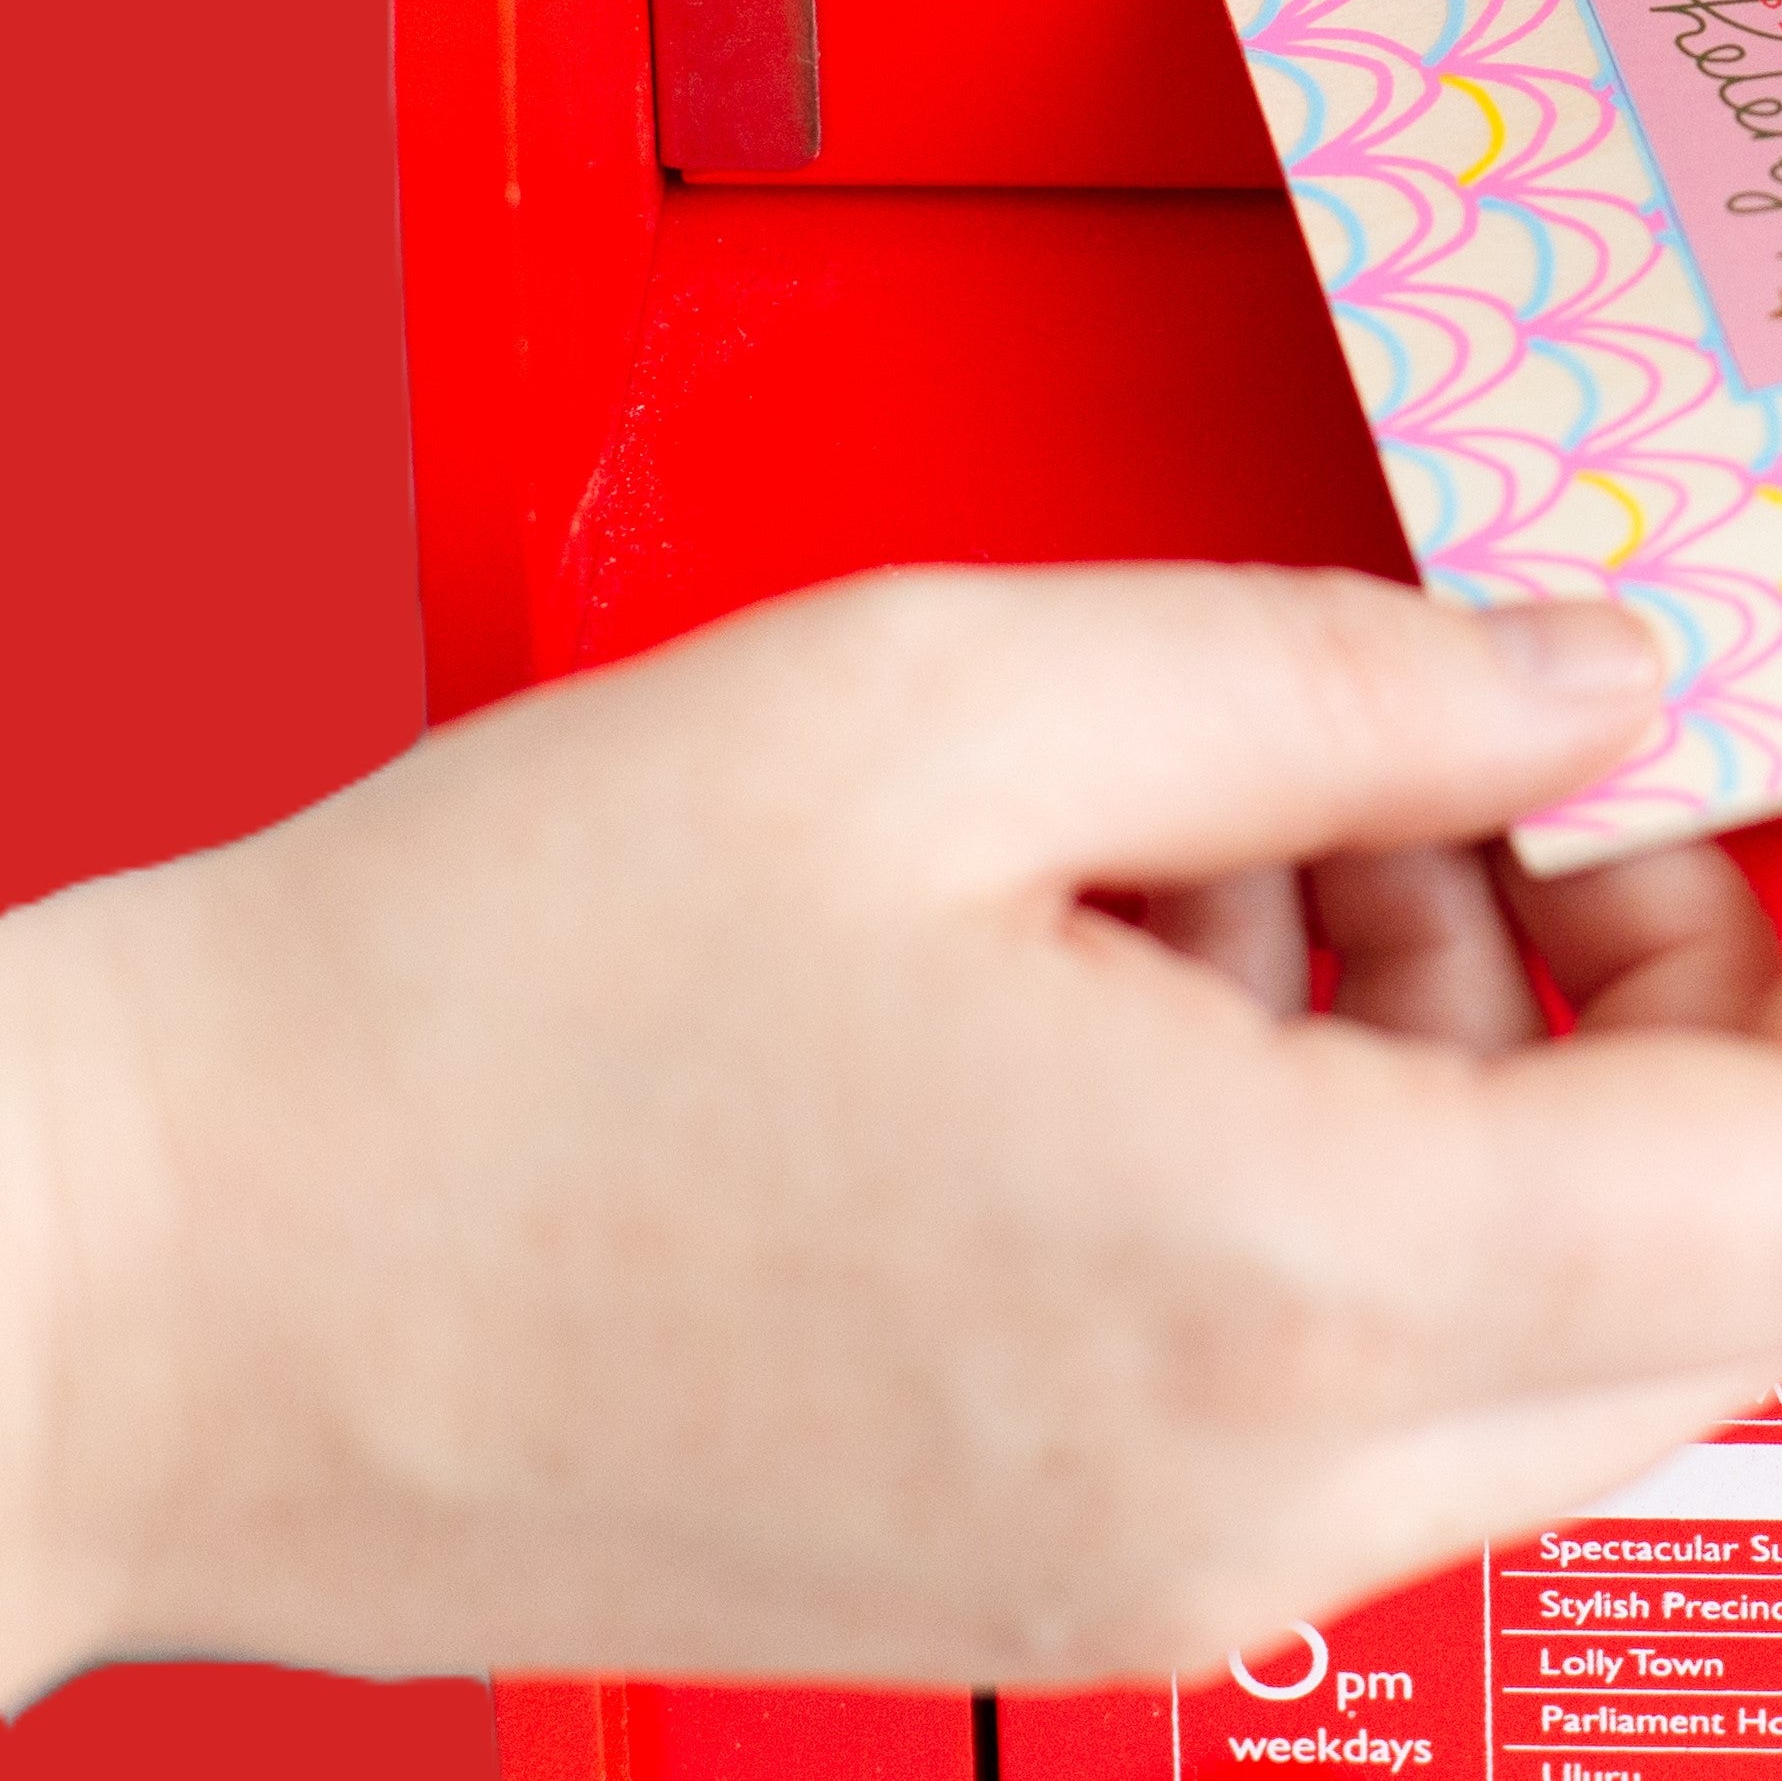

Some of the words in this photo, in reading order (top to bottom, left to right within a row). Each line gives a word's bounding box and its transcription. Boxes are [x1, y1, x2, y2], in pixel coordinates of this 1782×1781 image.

[1539, 1531, 1740, 1568] Spectacular
[1539, 1589, 1650, 1626] Stylish
[1539, 1647, 1624, 1684] Lolly
[1627, 1648, 1724, 1678] Town
[1541, 1704, 1726, 1735] Parliament
[1228, 1727, 1433, 1773] weekdays
